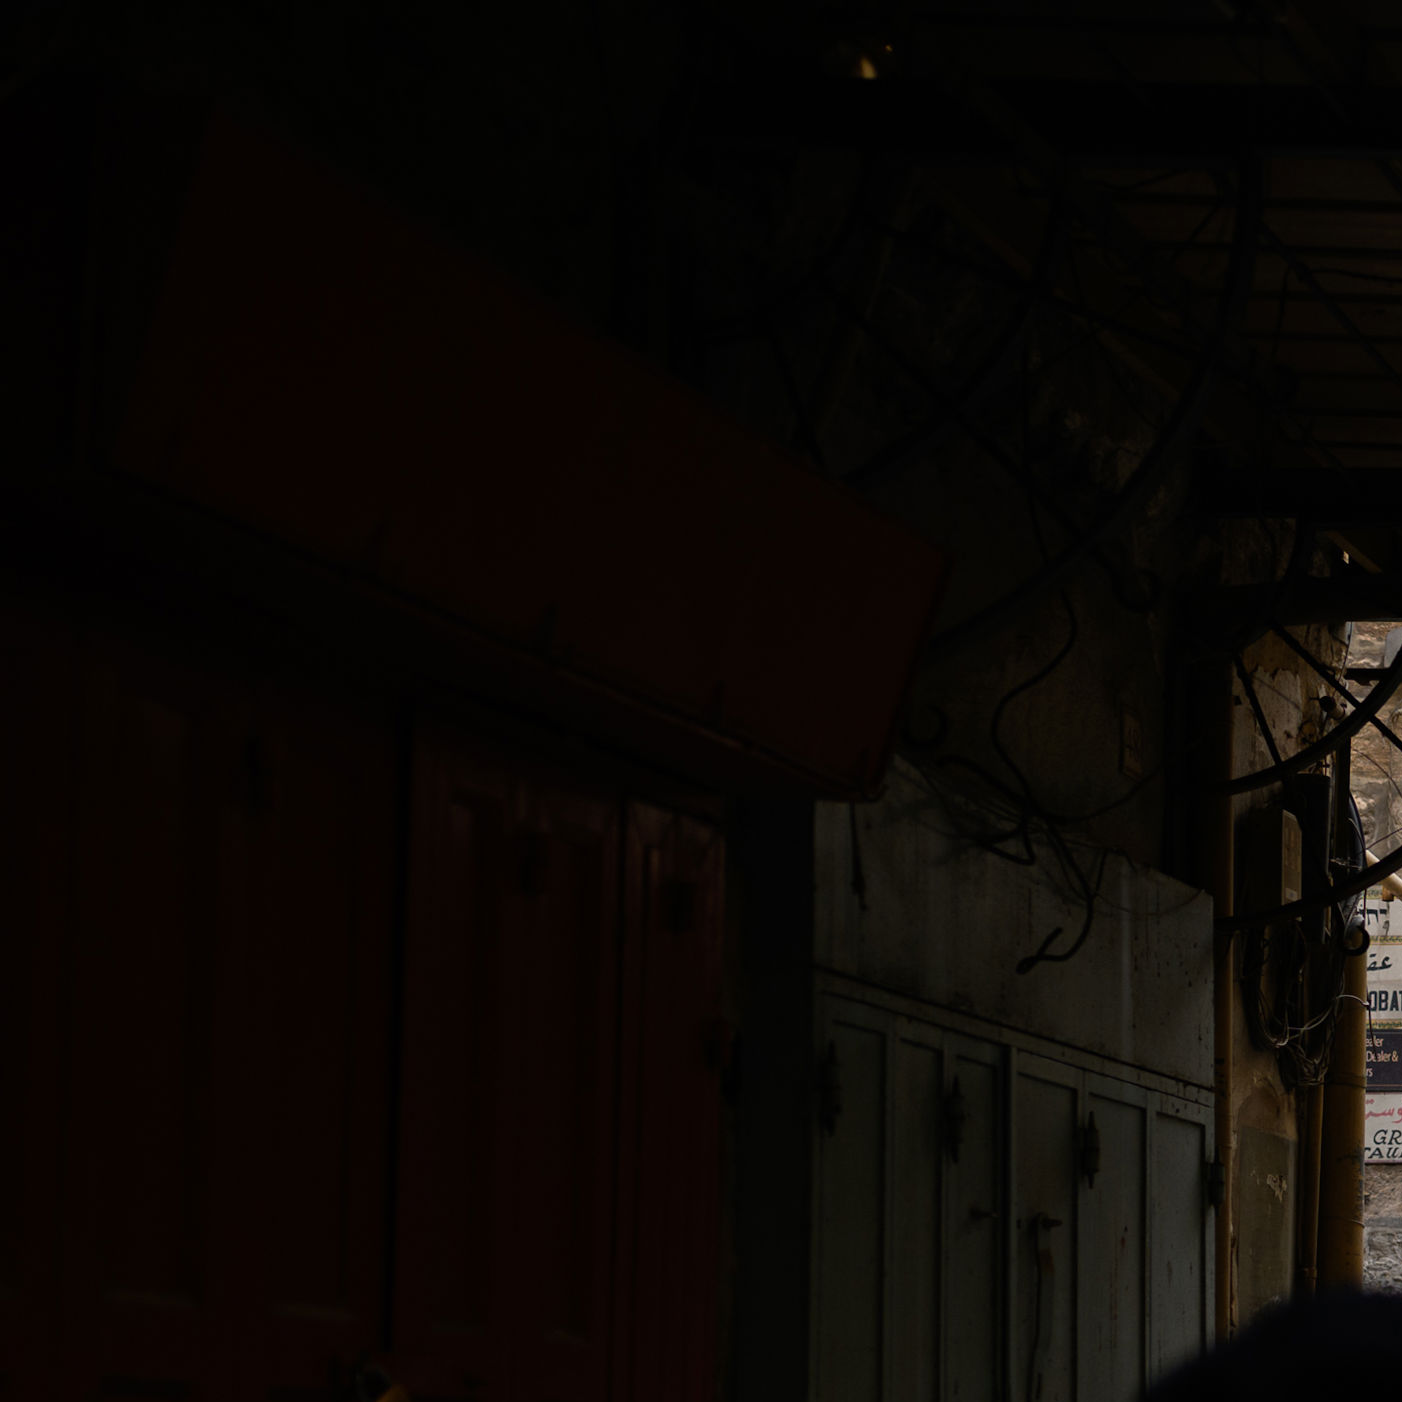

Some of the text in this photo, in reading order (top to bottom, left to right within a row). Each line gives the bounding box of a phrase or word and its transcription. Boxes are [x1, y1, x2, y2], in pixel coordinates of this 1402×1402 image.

[1366, 953, 1393, 971] عق
[1365, 1036, 1385, 1048] ealer
[1391, 1050, 1399, 1063] &
